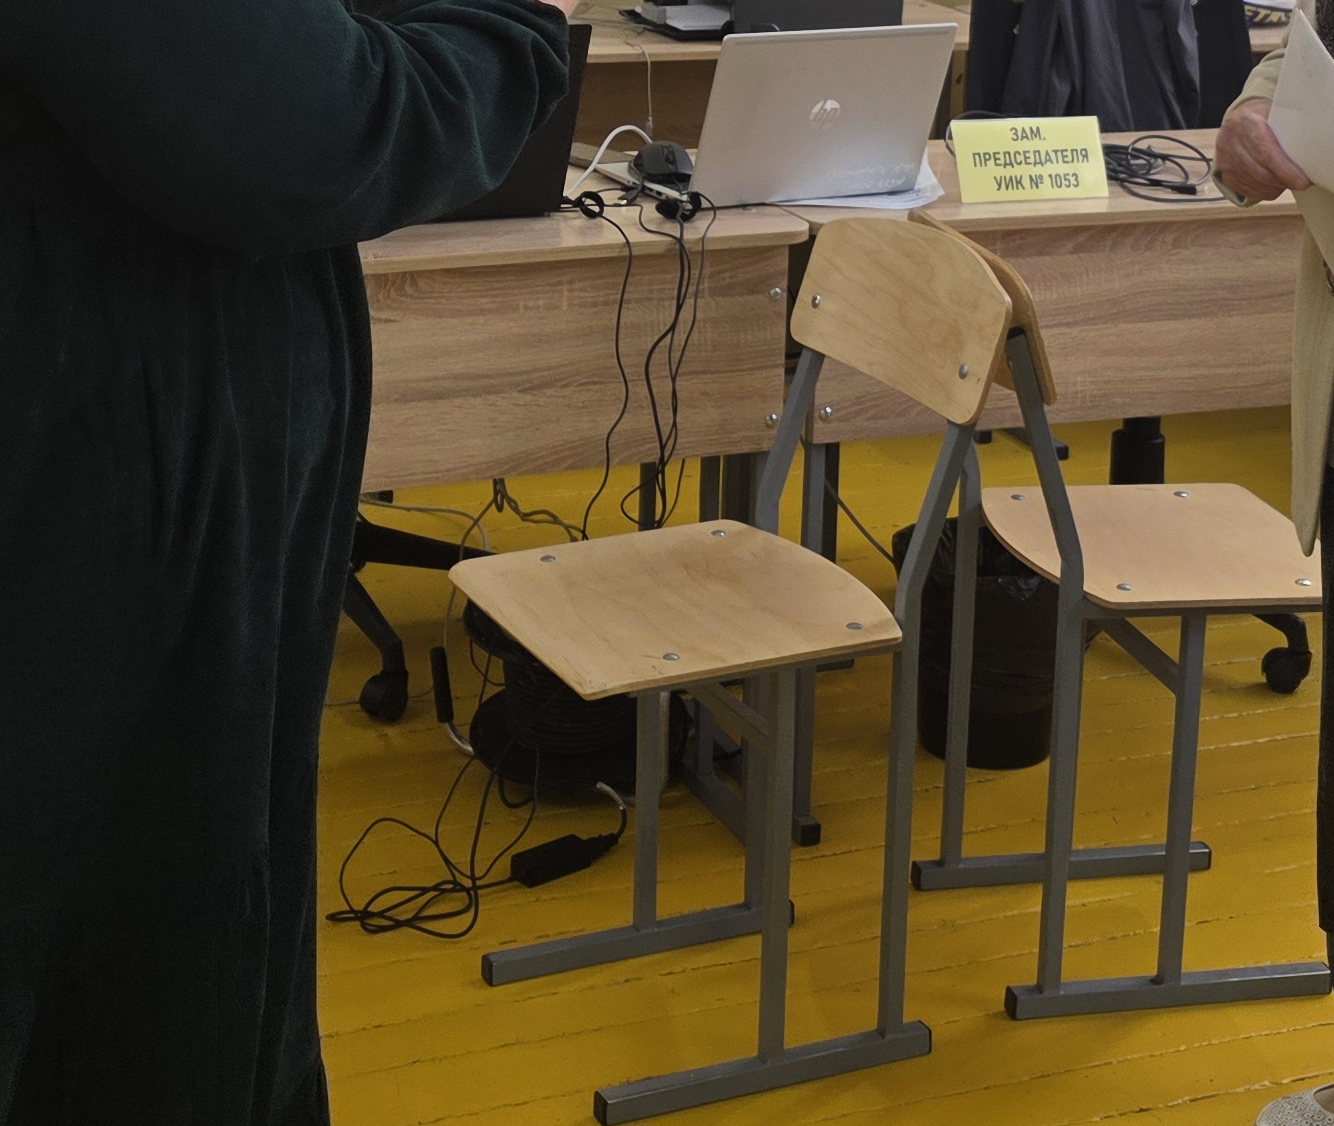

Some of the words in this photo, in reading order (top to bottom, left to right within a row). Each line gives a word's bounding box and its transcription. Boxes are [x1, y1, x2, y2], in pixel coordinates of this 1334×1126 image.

[1009, 126, 1046, 142] ЗАМ.
[972, 147, 1089, 168] ПРЕДСЕДАТЕЛЯ
[994, 174, 1026, 191] УИК
[1029, 174, 1044, 189] №
[1048, 172, 1080, 189] 1053
